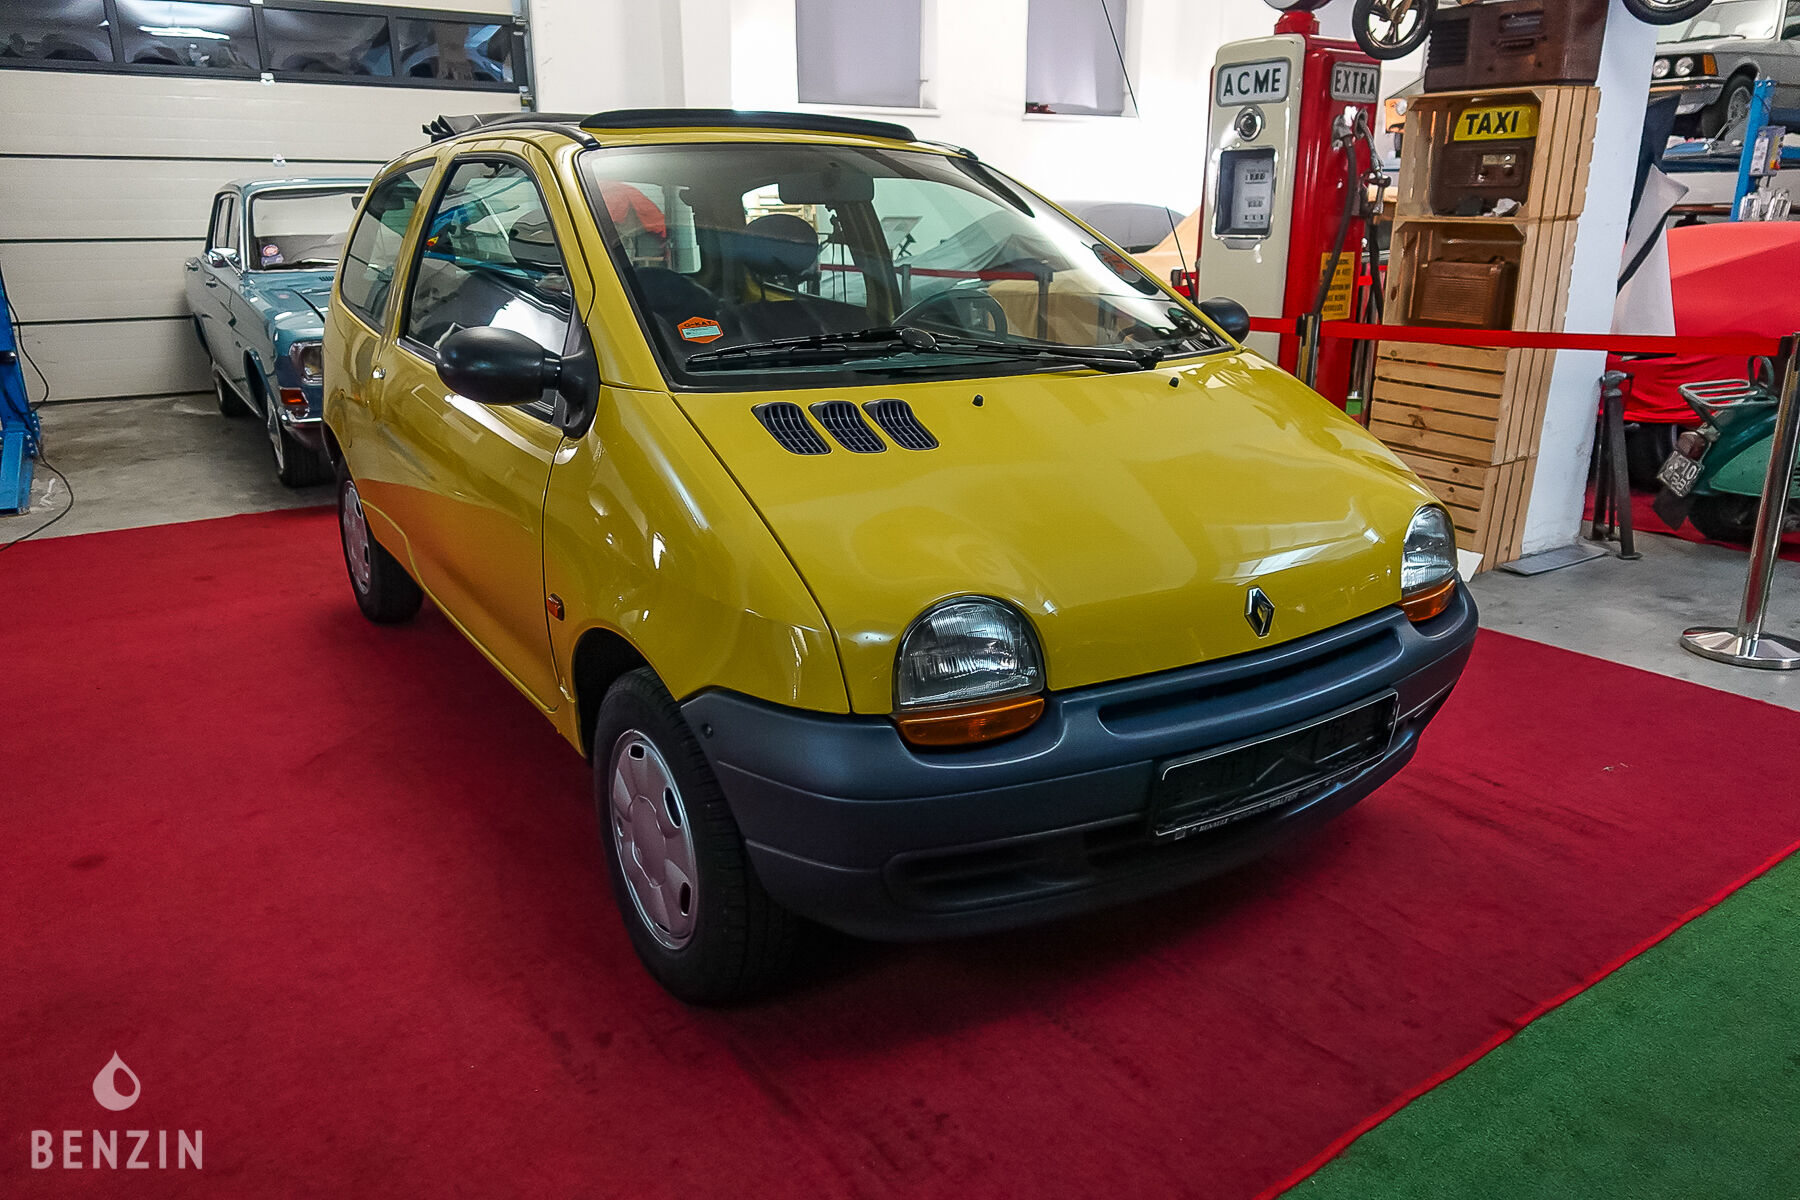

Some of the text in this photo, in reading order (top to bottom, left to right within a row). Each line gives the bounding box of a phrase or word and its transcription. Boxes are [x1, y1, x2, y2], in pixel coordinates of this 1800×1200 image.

[1223, 67, 1282, 97] ACME
[1334, 69, 1376, 95] EXTRA
[1465, 110, 1520, 135] TAXI
